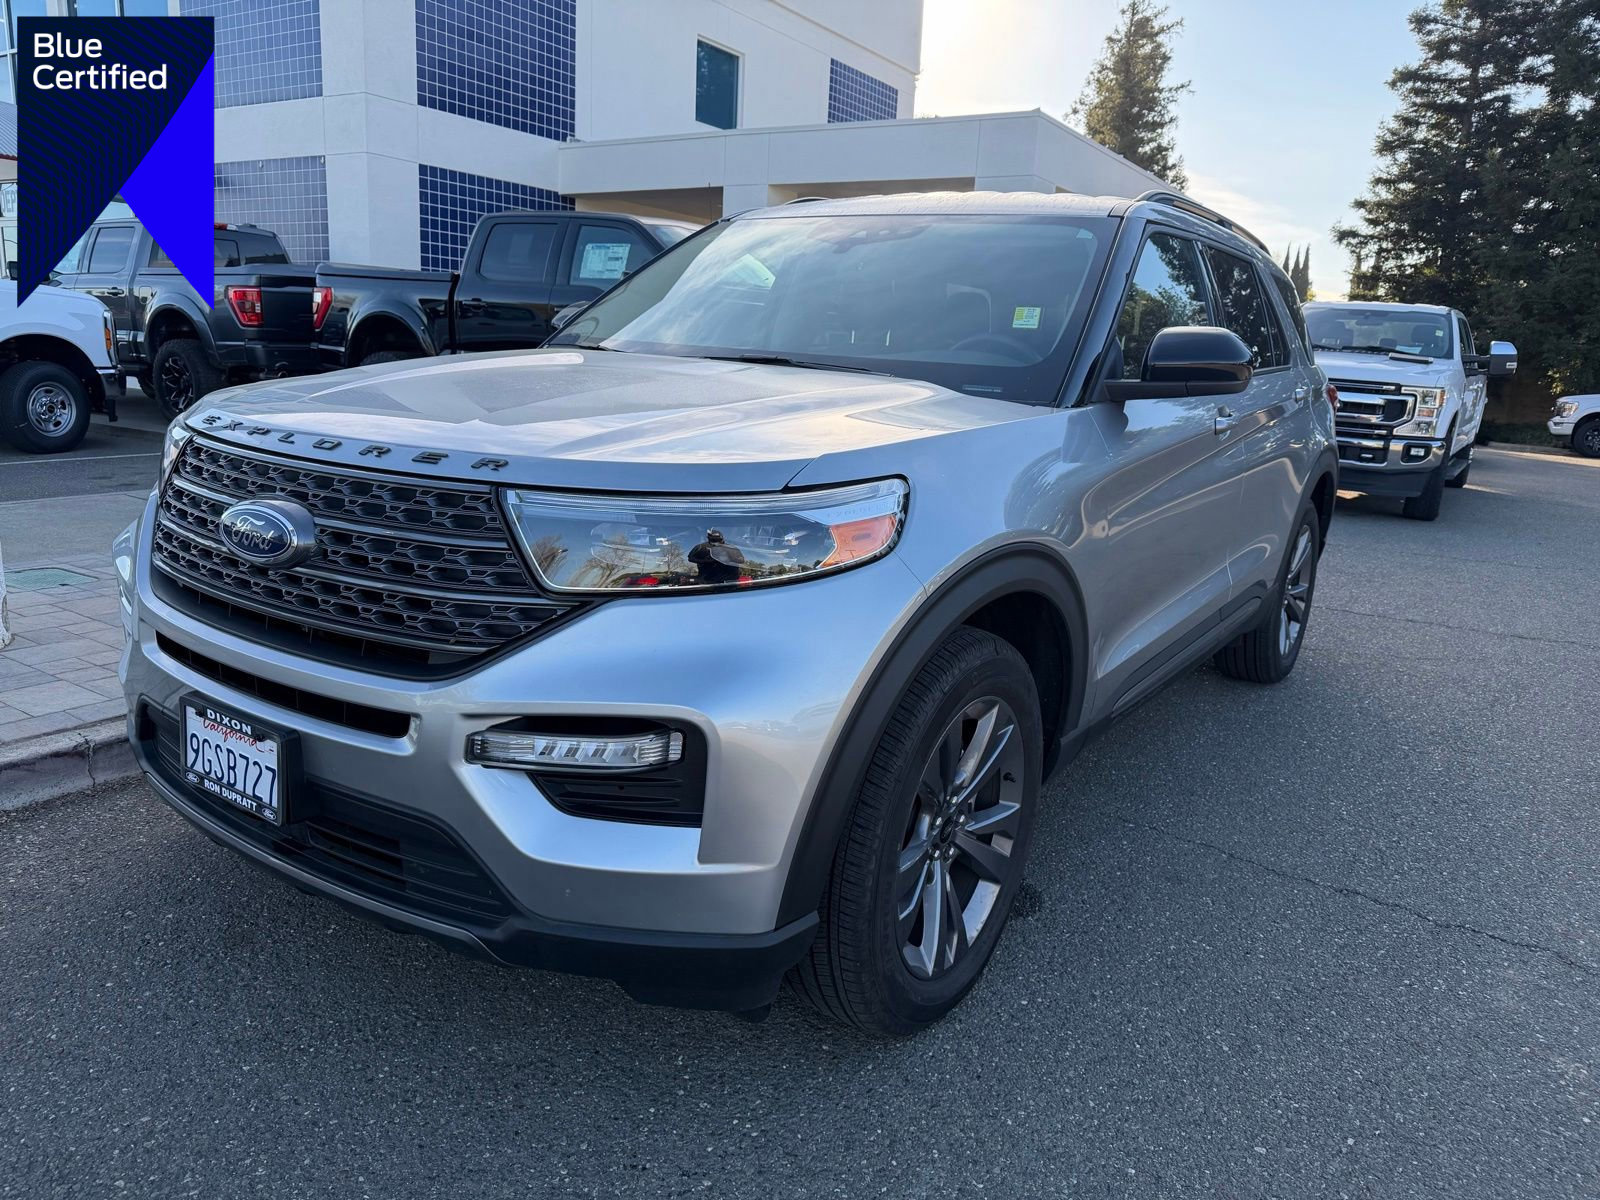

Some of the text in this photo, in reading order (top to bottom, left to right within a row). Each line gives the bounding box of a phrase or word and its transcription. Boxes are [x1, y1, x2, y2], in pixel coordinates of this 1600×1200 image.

[201, 415, 509, 471] EXPLORER
[231, 515, 275, 551] Ford
[206, 708, 252, 735] DIXON
[189, 732, 277, 807] 9GSB727
[204, 779, 257, 811] RON DUPRATT
